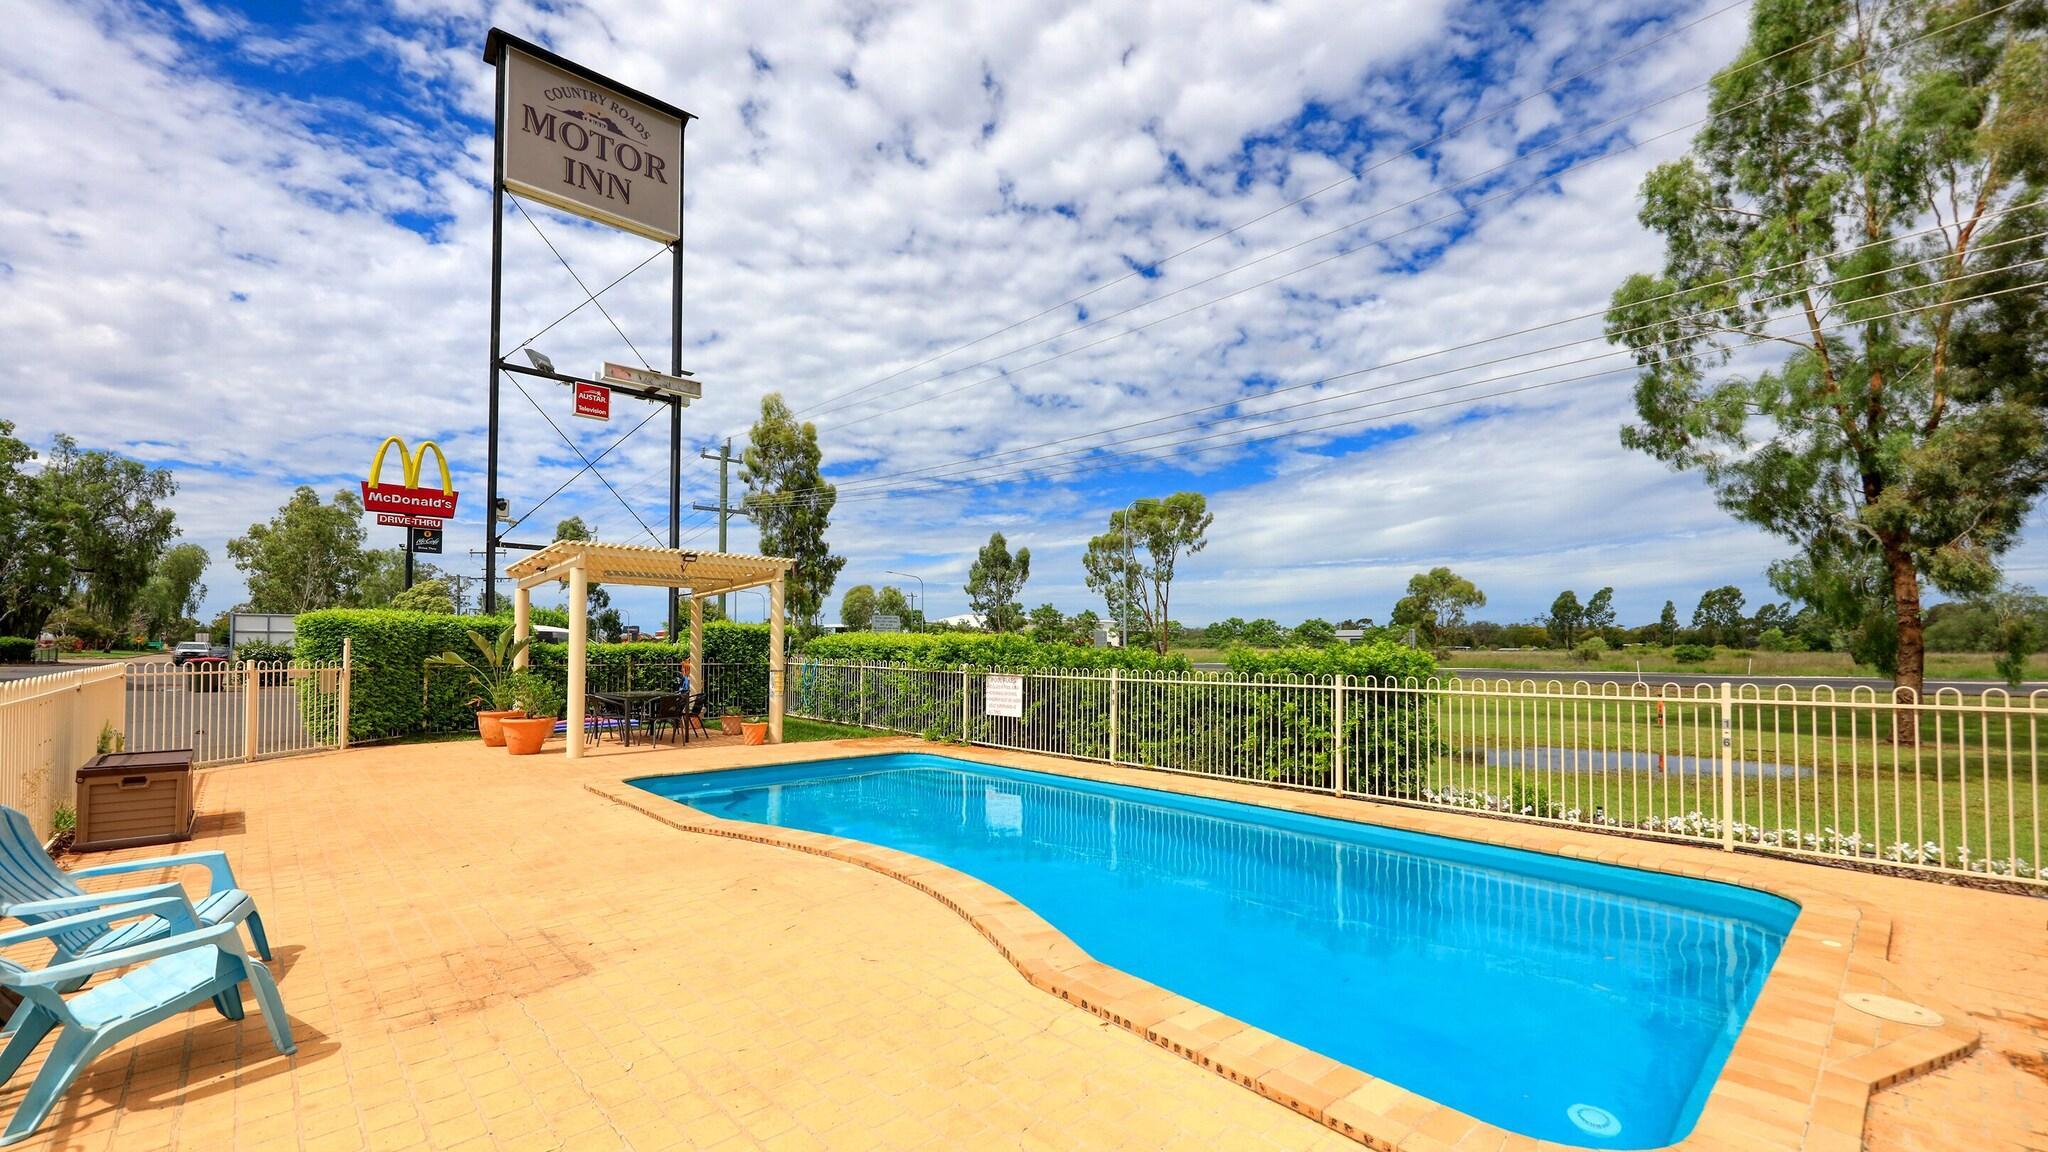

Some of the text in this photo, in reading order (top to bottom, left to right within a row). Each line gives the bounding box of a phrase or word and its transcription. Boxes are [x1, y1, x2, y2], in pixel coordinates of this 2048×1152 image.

[544, 86, 651, 141] COUNTRY ROADS
[521, 103, 668, 184] MOTOR
[563, 156, 632, 205] INN
[578, 392, 607, 404] AUSTAR
[578, 405, 607, 415] Television
[368, 492, 452, 509] McDonald's
[379, 515, 440, 527] DRIVE-THRU
